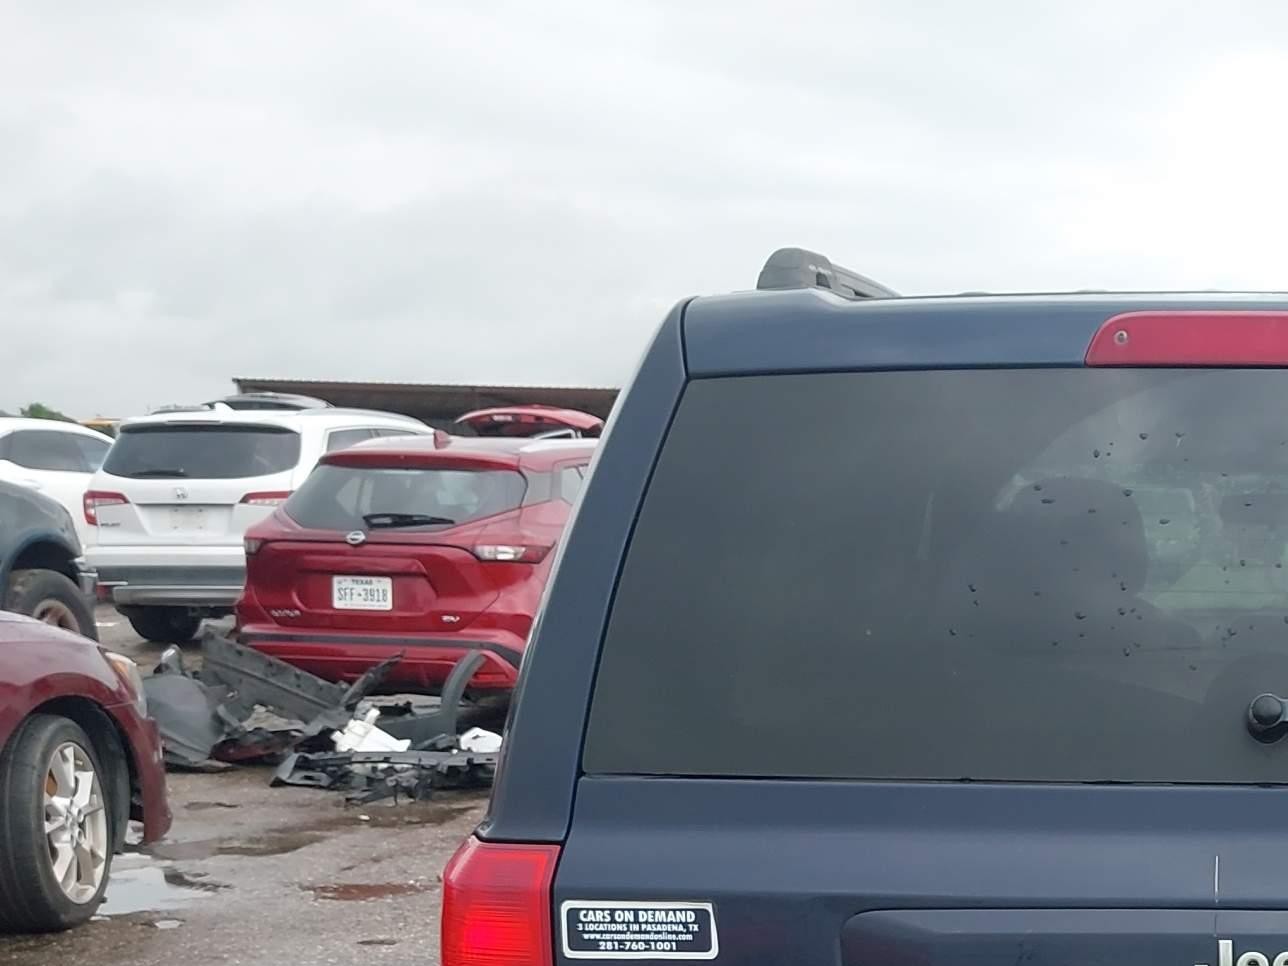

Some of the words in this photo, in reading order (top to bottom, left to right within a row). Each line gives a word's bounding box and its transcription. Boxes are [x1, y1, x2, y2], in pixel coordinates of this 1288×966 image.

[579, 910, 611, 922] CARS
[615, 910, 634, 922] ON
[638, 910, 696, 923] DEMAND
[576, 923, 583, 931] 3
[585, 923, 628, 931] LOCATIONS
[641, 923, 687, 932] PASADENA,
[688, 923, 699, 931] TX
[599, 941, 677, 950] 281-760-1001
